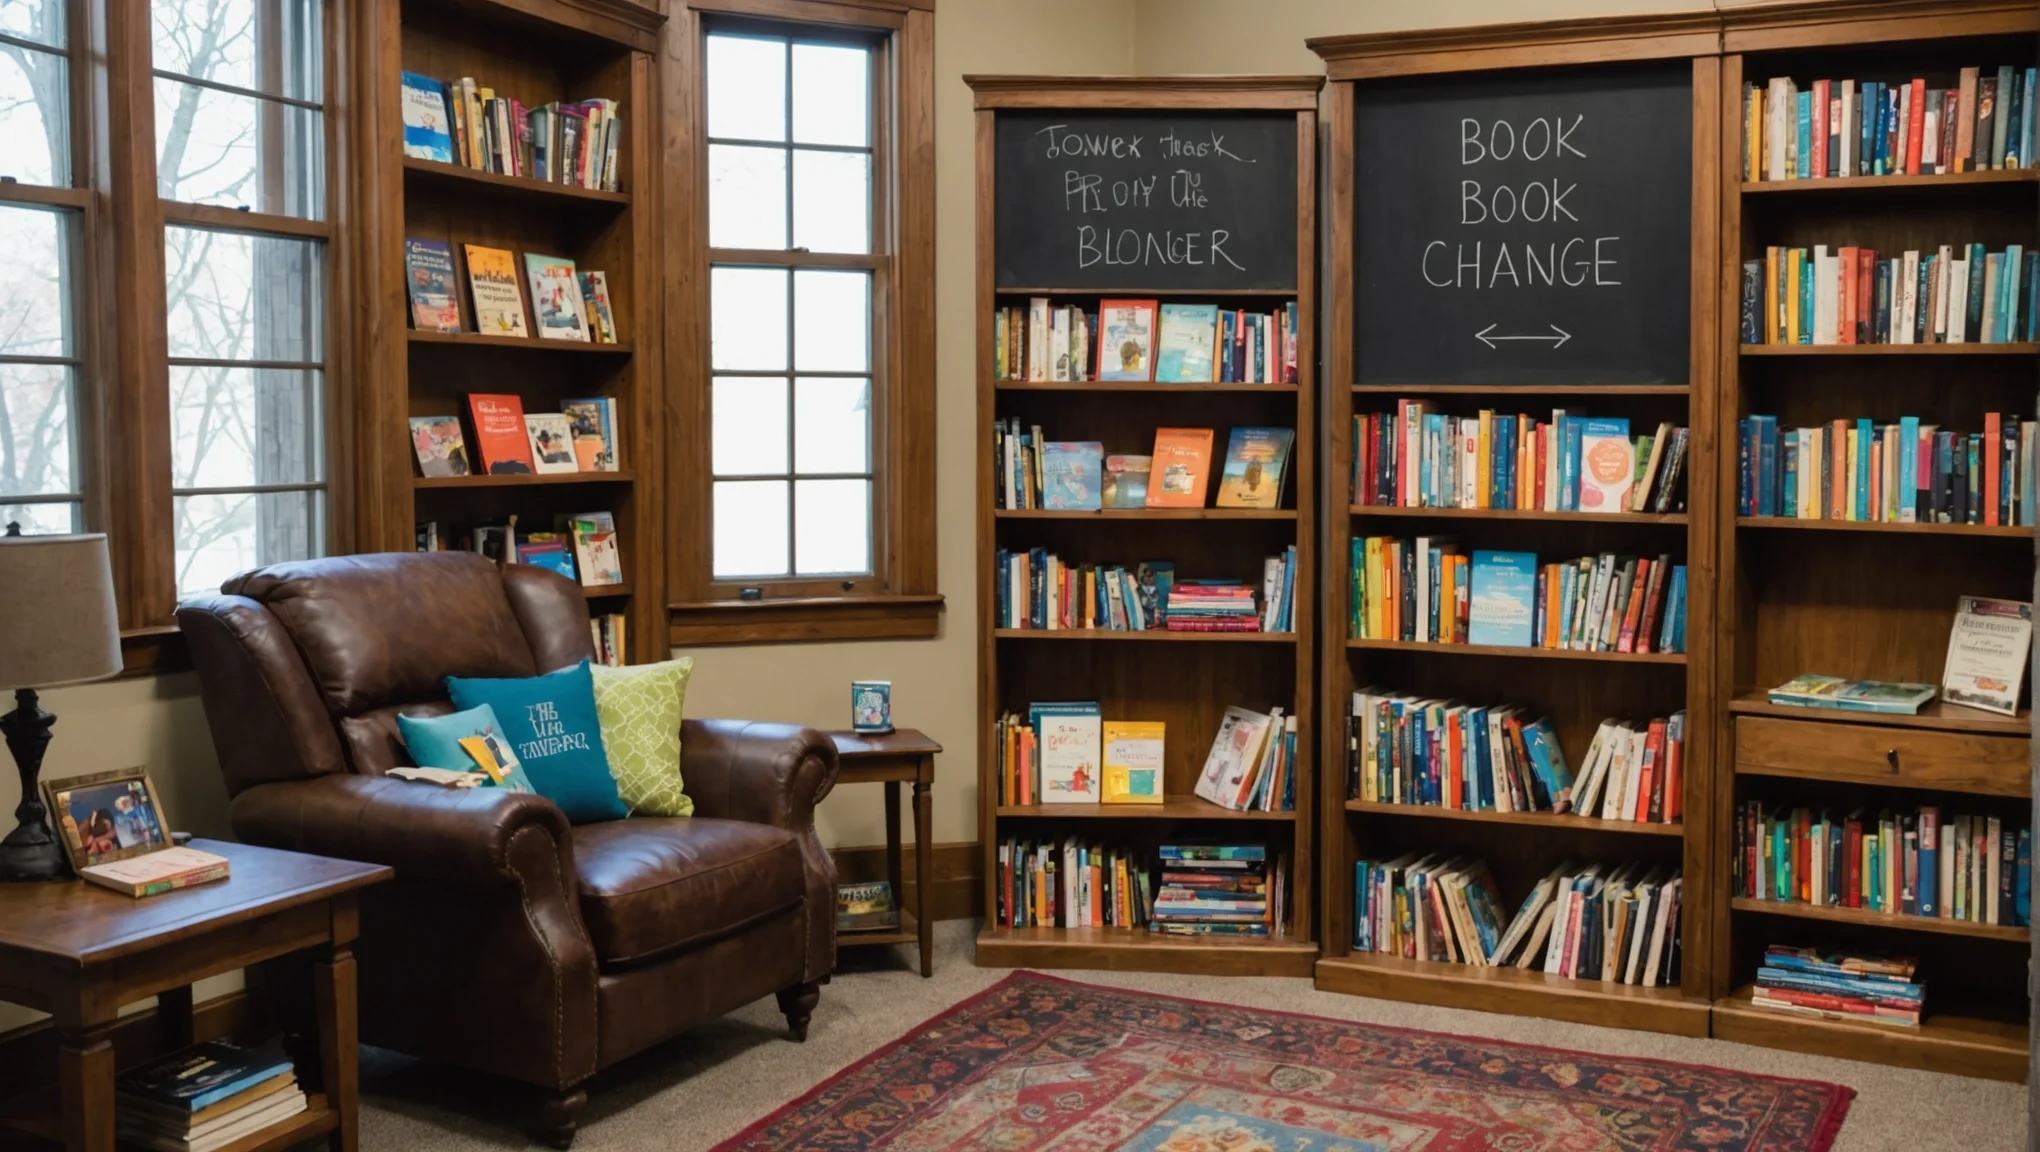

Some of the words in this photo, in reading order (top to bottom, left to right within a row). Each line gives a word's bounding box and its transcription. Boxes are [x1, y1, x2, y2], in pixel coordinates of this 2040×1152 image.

[1461, 114, 1587, 165] BOOK
[1461, 178, 1580, 224] BOOK
[1422, 236, 1622, 289] CHANGE
